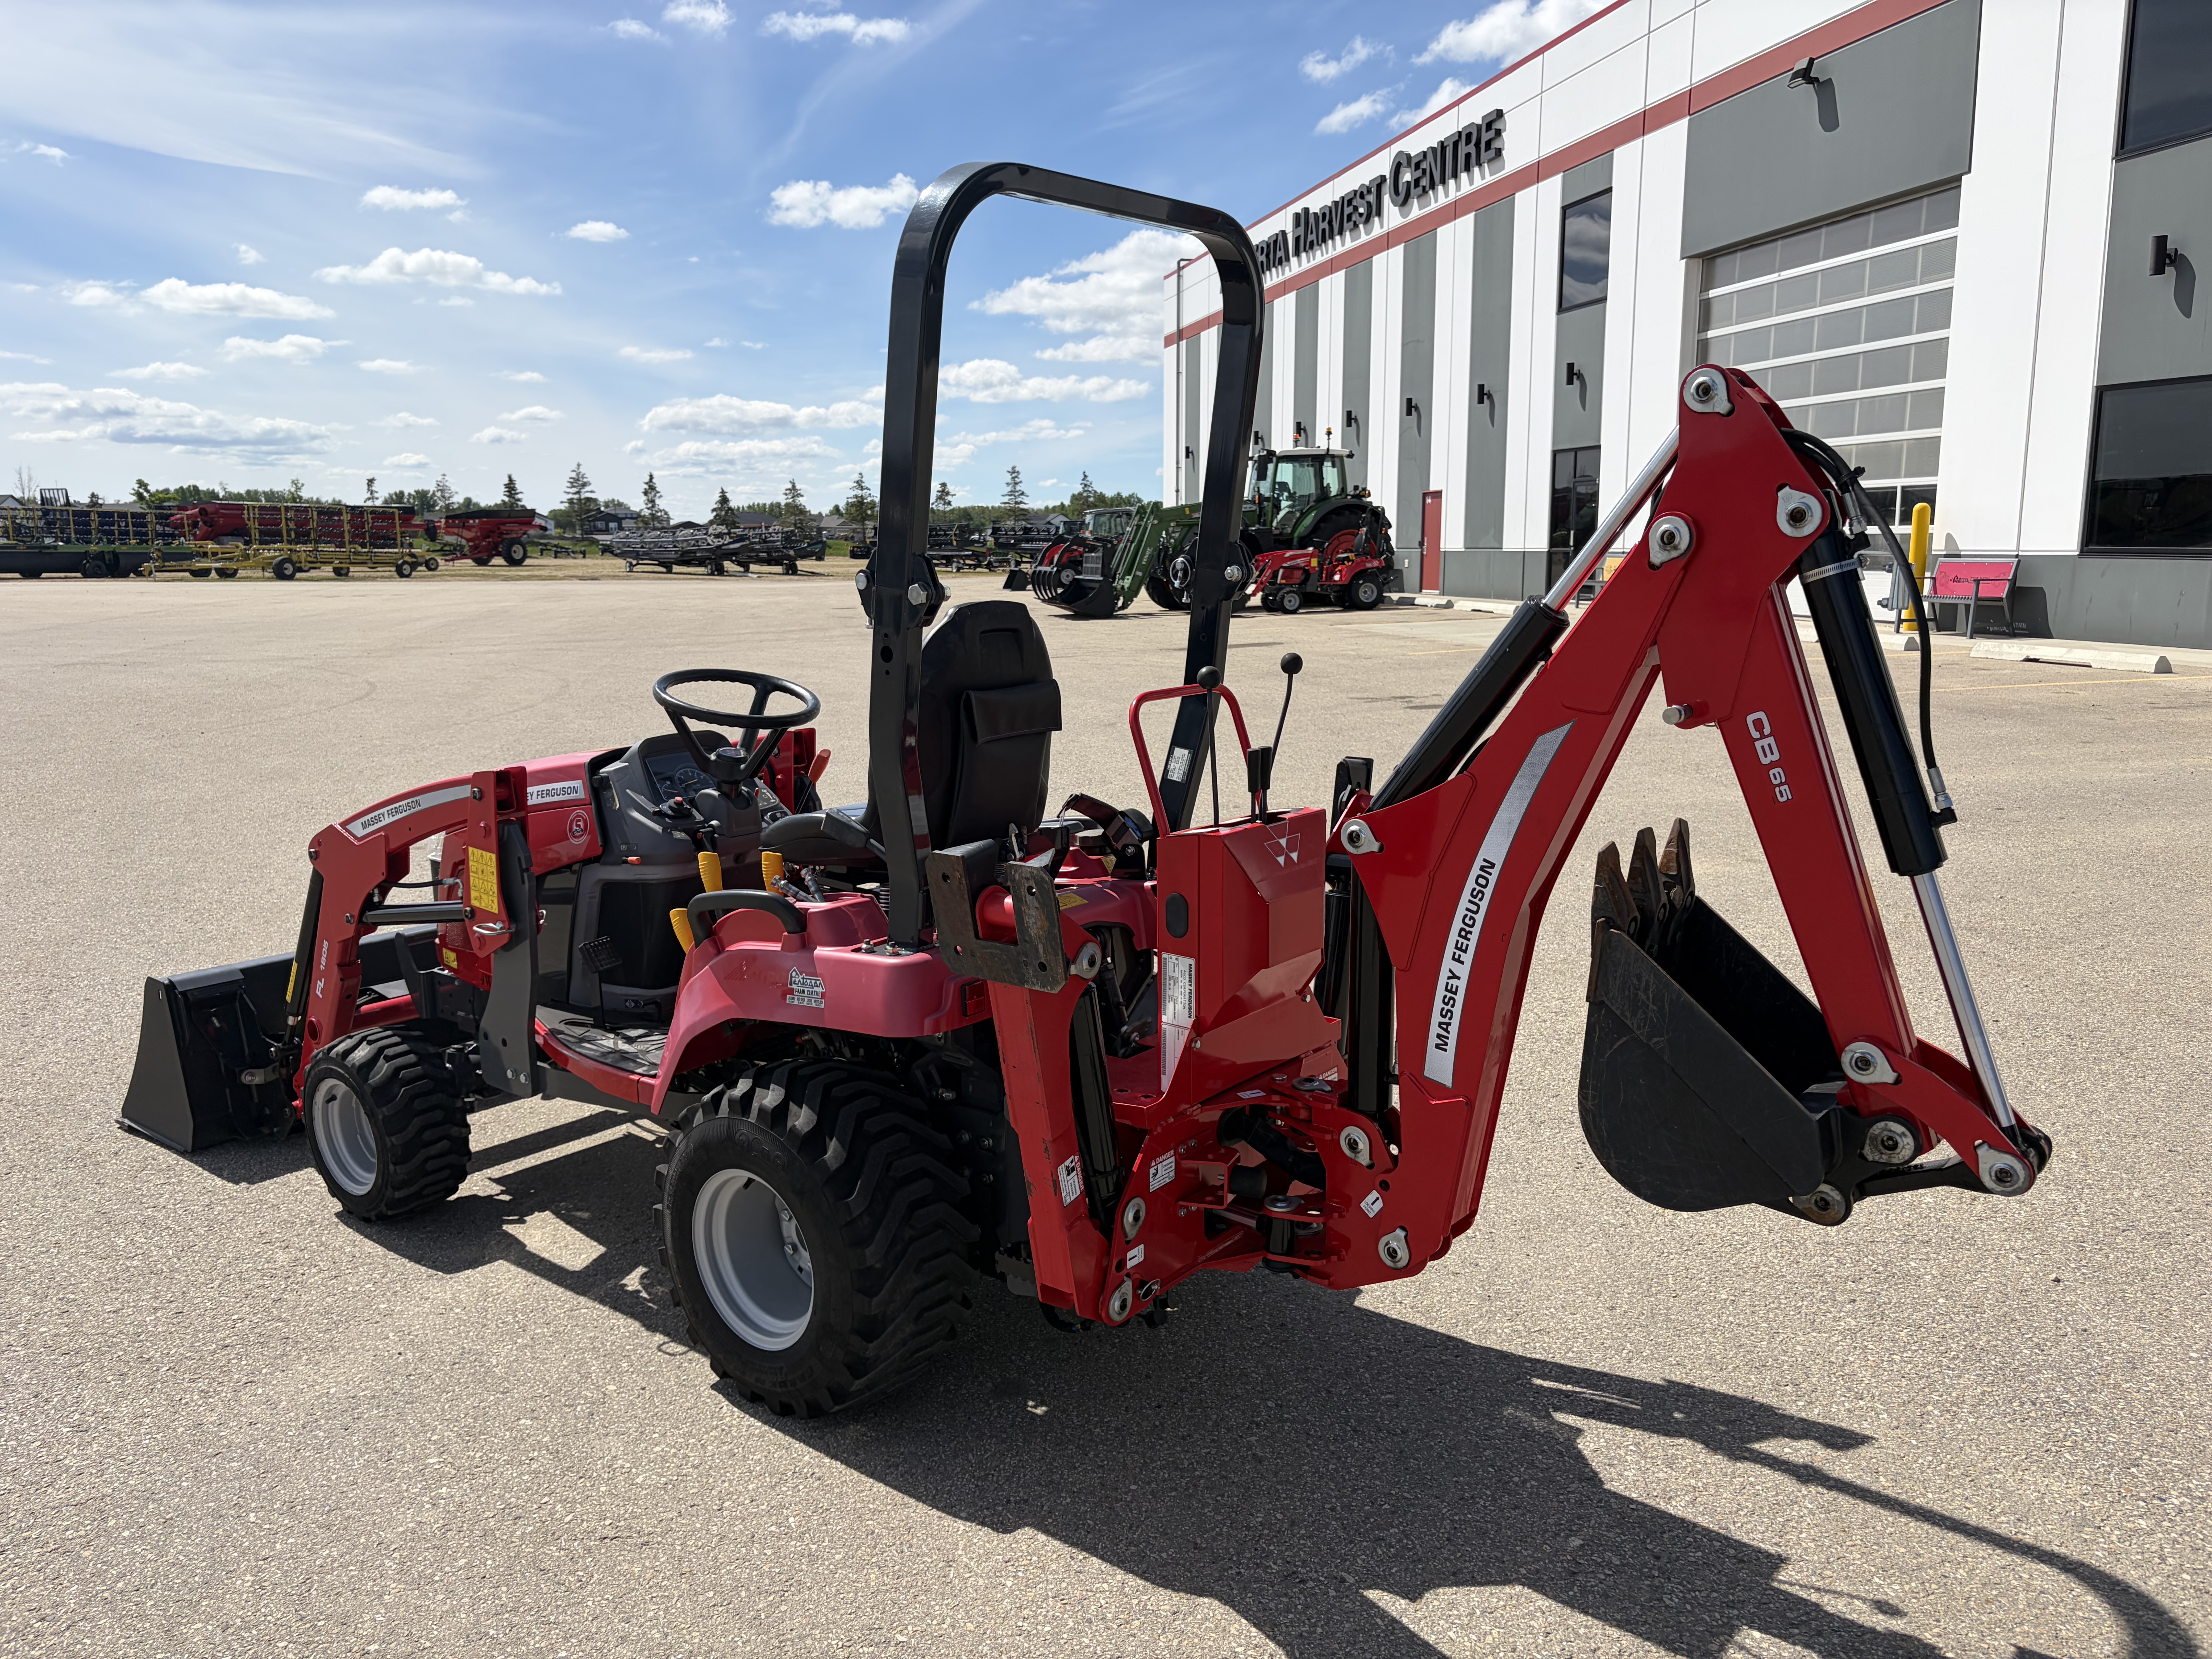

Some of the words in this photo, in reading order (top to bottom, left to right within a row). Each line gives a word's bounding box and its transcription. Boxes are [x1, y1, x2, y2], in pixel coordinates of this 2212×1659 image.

[1292, 174, 1386, 258] HARVEST
[1389, 108, 1503, 207] CENTRE
[536, 785, 579, 799] FERGUSON
[361, 811, 385, 830] MASSEY
[386, 799, 421, 819] FERGUSON
[320, 939, 328, 971] 1806
[1435, 968, 1461, 1053] MASSEY
[1451, 858, 1496, 965] FERGUSON
[316, 977, 325, 998] FL
[1323, 1067, 1337, 1079] DANGER
[1156, 1149, 1174, 1164] DANGER
[1076, 1163, 1084, 1191] DANGER
